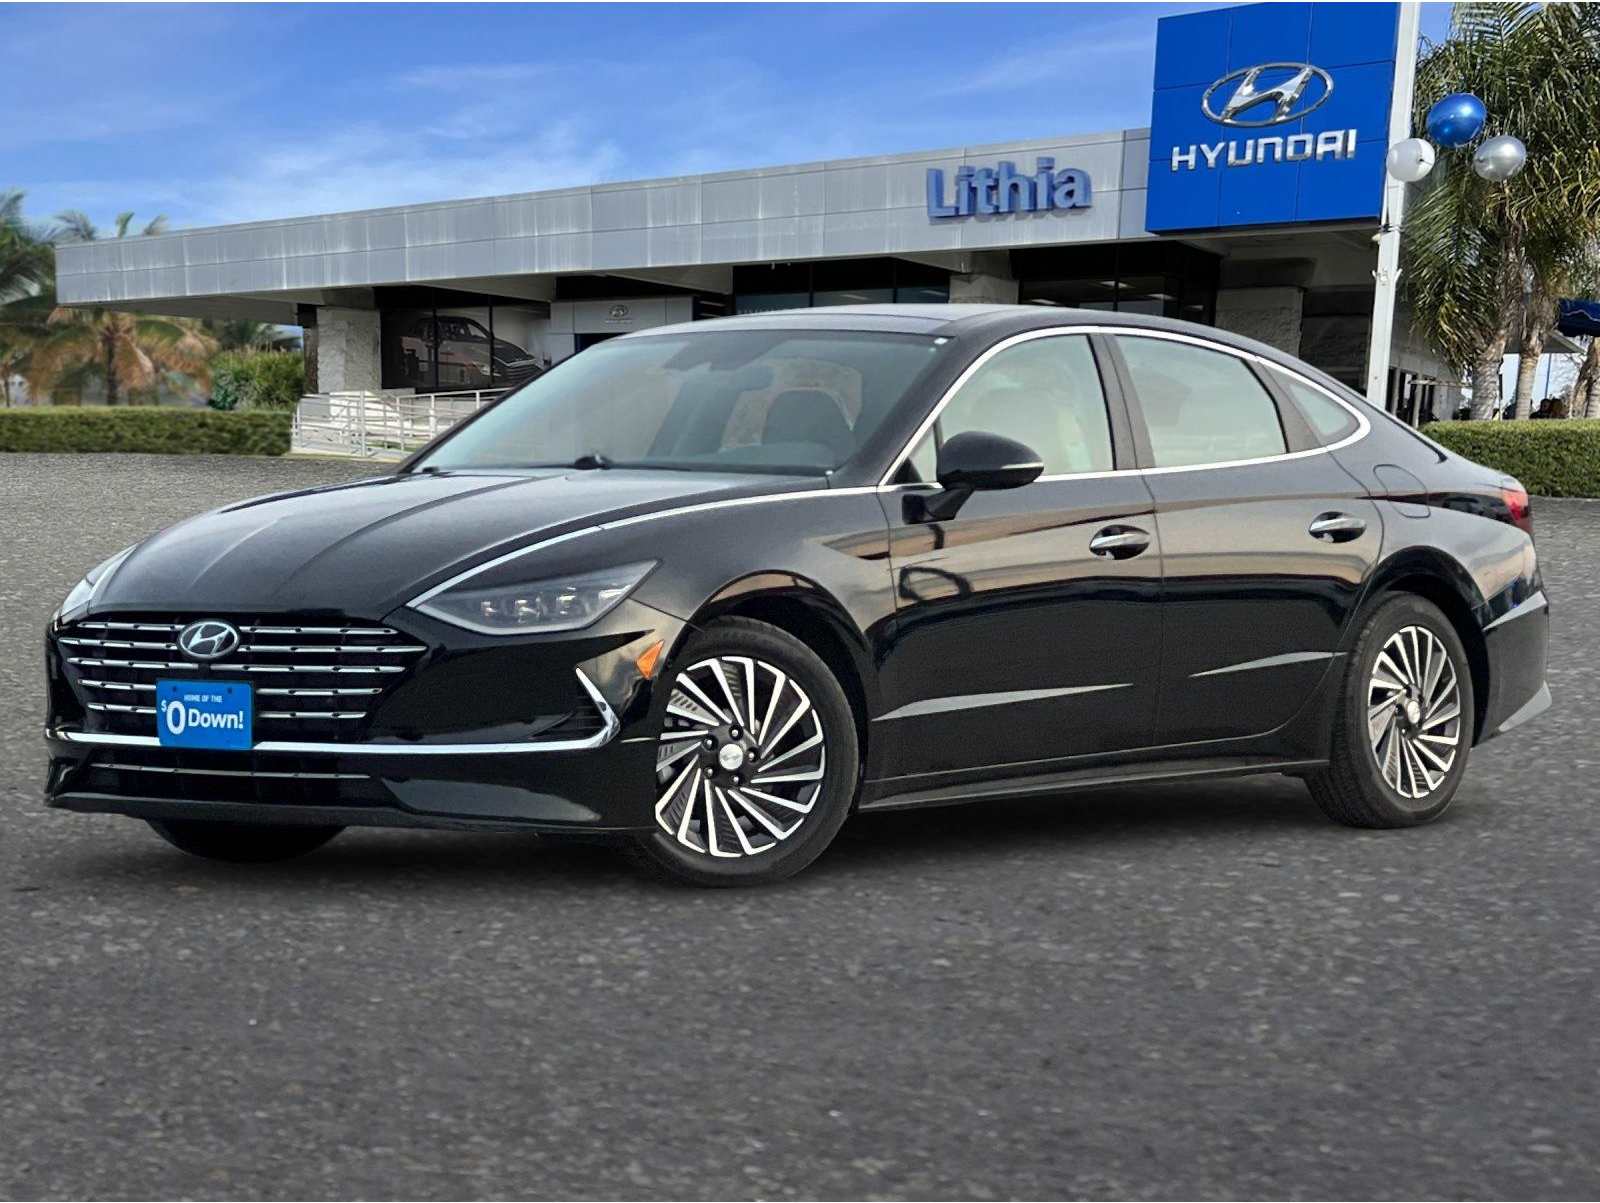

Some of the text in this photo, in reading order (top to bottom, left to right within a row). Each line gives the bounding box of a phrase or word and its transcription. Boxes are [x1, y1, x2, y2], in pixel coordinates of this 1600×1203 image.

[1171, 129, 1357, 171] HYUNDAI
[926, 156, 1093, 219] Lithia
[183, 694, 223, 703] HOME OF THE
[188, 708, 244, 729] Down!
